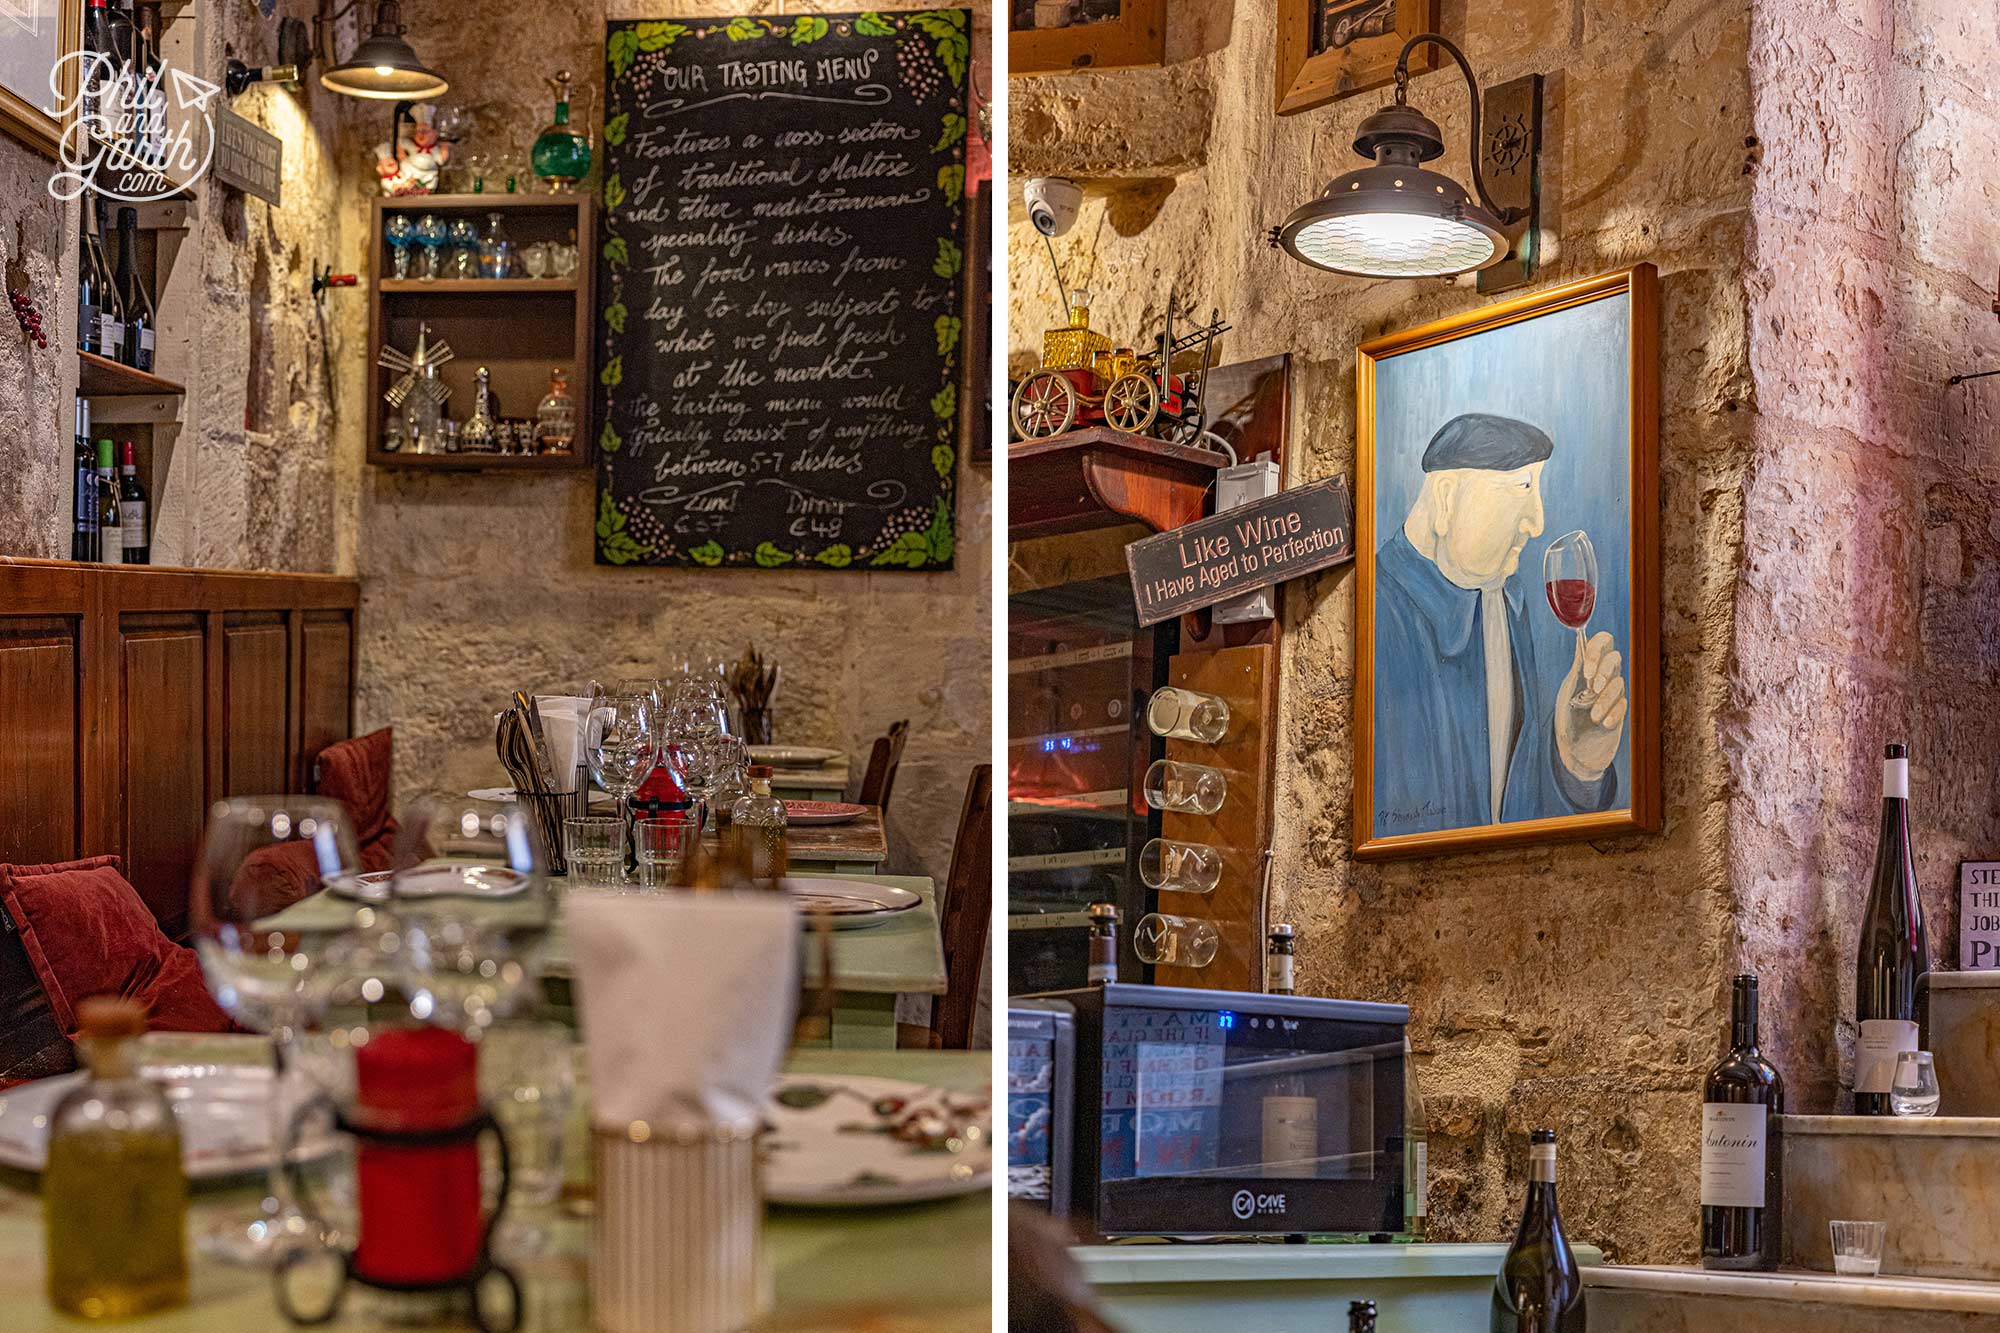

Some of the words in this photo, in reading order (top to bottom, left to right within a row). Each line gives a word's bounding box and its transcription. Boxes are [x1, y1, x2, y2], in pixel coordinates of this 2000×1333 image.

[656, 60, 709, 92] OUR
[717, 60, 807, 88] TASTING
[816, 48, 879, 84] MENU
[633, 126, 731, 159] Features
[742, 134, 763, 149] a
[632, 165, 664, 206] of
[677, 157, 814, 190] traditional
[818, 151, 917, 183] Maltese
[677, 194, 742, 220] other
[640, 220, 759, 259] speciality
[772, 220, 853, 247] dishes.
[643, 254, 686, 285] The
[692, 254, 756, 298] food
[764, 259, 831, 278] varies
[832, 245, 907, 287] from
[705, 290, 740, 318] to
[804, 287, 900, 330] subject
[911, 283, 942, 311] to
[655, 327, 716, 353] what
[733, 334, 767, 350] we
[768, 320, 828, 363] find
[834, 315, 907, 357] fresh
[672, 360, 713, 389] at
[718, 358, 766, 387] the
[773, 350, 889, 383] market.
[671, 389, 752, 427] tasting
[765, 397, 823, 412] menu
[841, 383, 908, 411] would
[722, 418, 809, 442] consist
[808, 416, 832, 451] of
[834, 413, 930, 450] anything
[653, 449, 748, 482] between
[750, 451, 784, 473] 5-7
[790, 445, 864, 474] dishes
[1178, 534, 1230, 569] Like
[1234, 511, 1301, 548] Wine
[1145, 583, 1152, 605] I
[1155, 575, 1195, 602] Have
[1199, 556, 1239, 589] Aged
[1240, 553, 1259, 573] to
[1262, 526, 1345, 567] Perfection
[1969, 915, 2000, 931] JOB
[1256, 1193, 1287, 1208] CAVE
